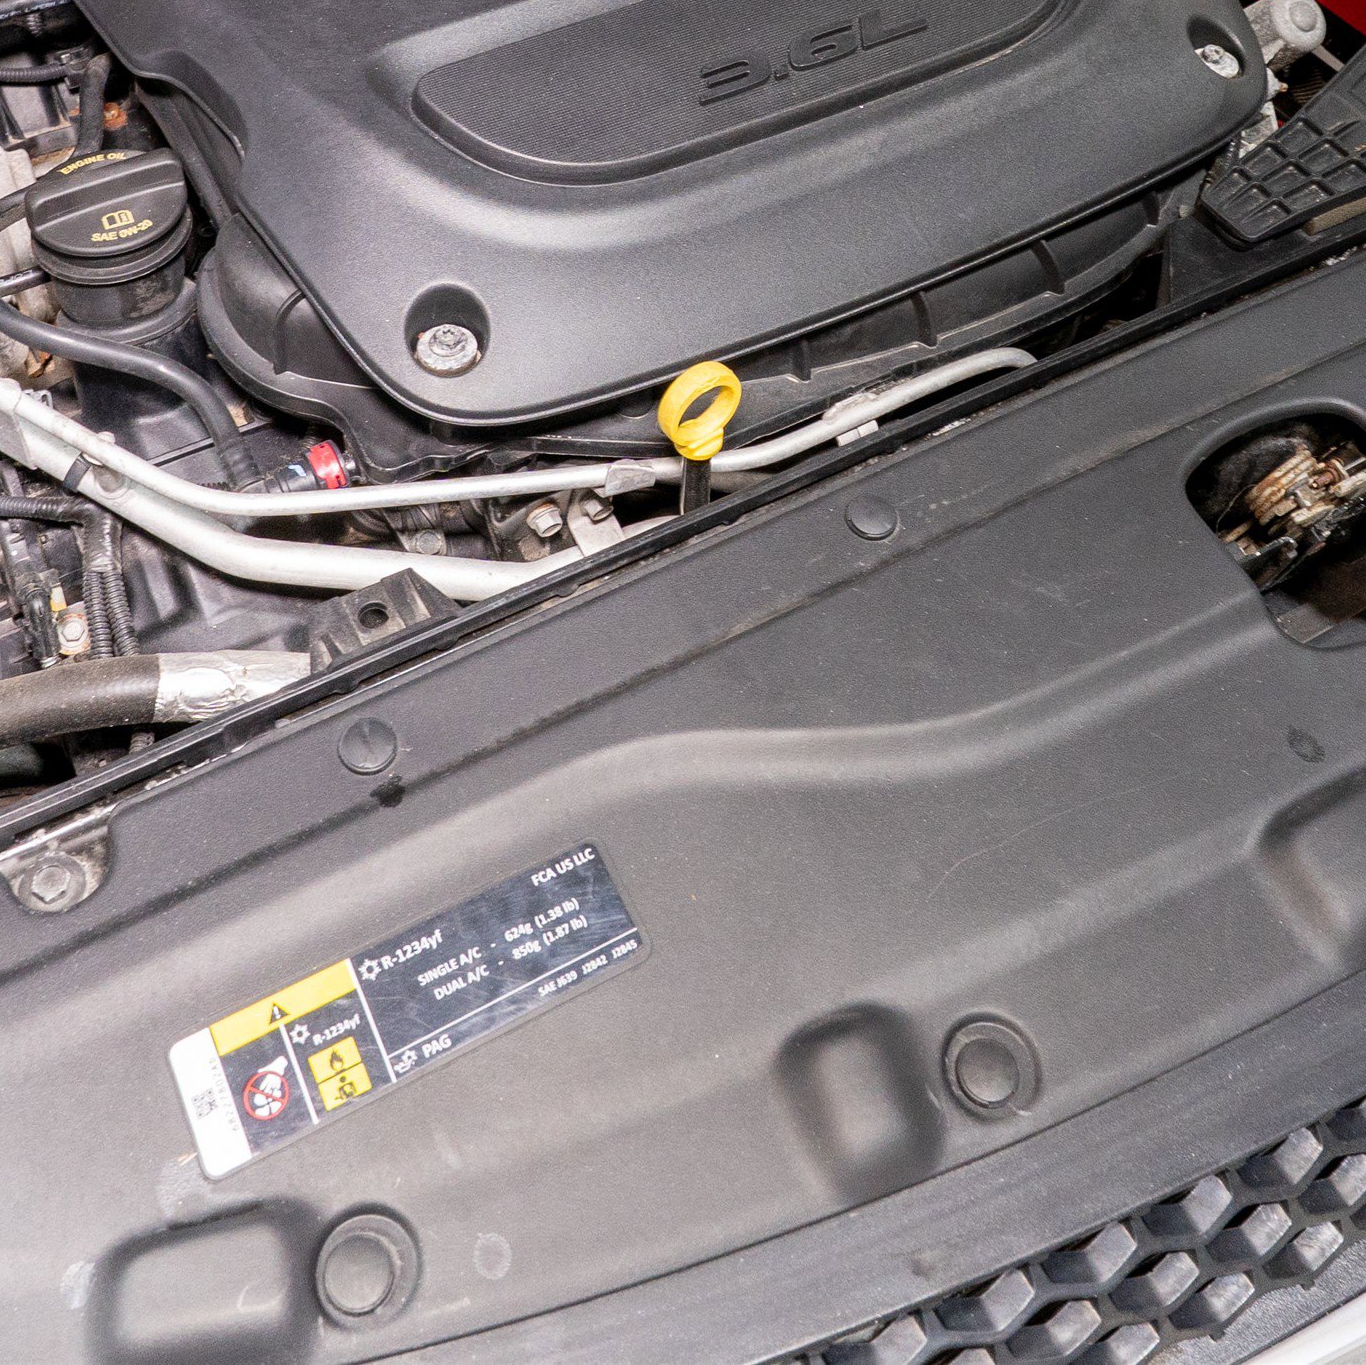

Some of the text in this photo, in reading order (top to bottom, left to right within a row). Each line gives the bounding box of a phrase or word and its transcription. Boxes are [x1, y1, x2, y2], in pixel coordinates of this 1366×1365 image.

[697, 9, 929, 106] 3.6L
[57, 151, 126, 175] ENGINE OIL
[90, 219, 153, 242] SAE 0W-20
[531, 847, 596, 886] FCA US LLC
[380, 929, 444, 970] R-1234yf
[417, 958, 459, 986] SINGLE
[458, 946, 482, 967] A/C
[503, 922, 534, 942] 624g
[535, 905, 563, 929] (1.38
[561, 897, 580, 914] lb)
[433, 976, 467, 1000] DUAL
[467, 964, 490, 984] A/C
[512, 940, 542, 960] 850g
[543, 922, 571, 946] (1.87
[569, 914, 588, 932] lb)
[538, 938, 638, 997] SAE J639 J2842 J2845
[312, 1013, 362, 1047] R-1234yf
[421, 1033, 453, 1058] PAG
